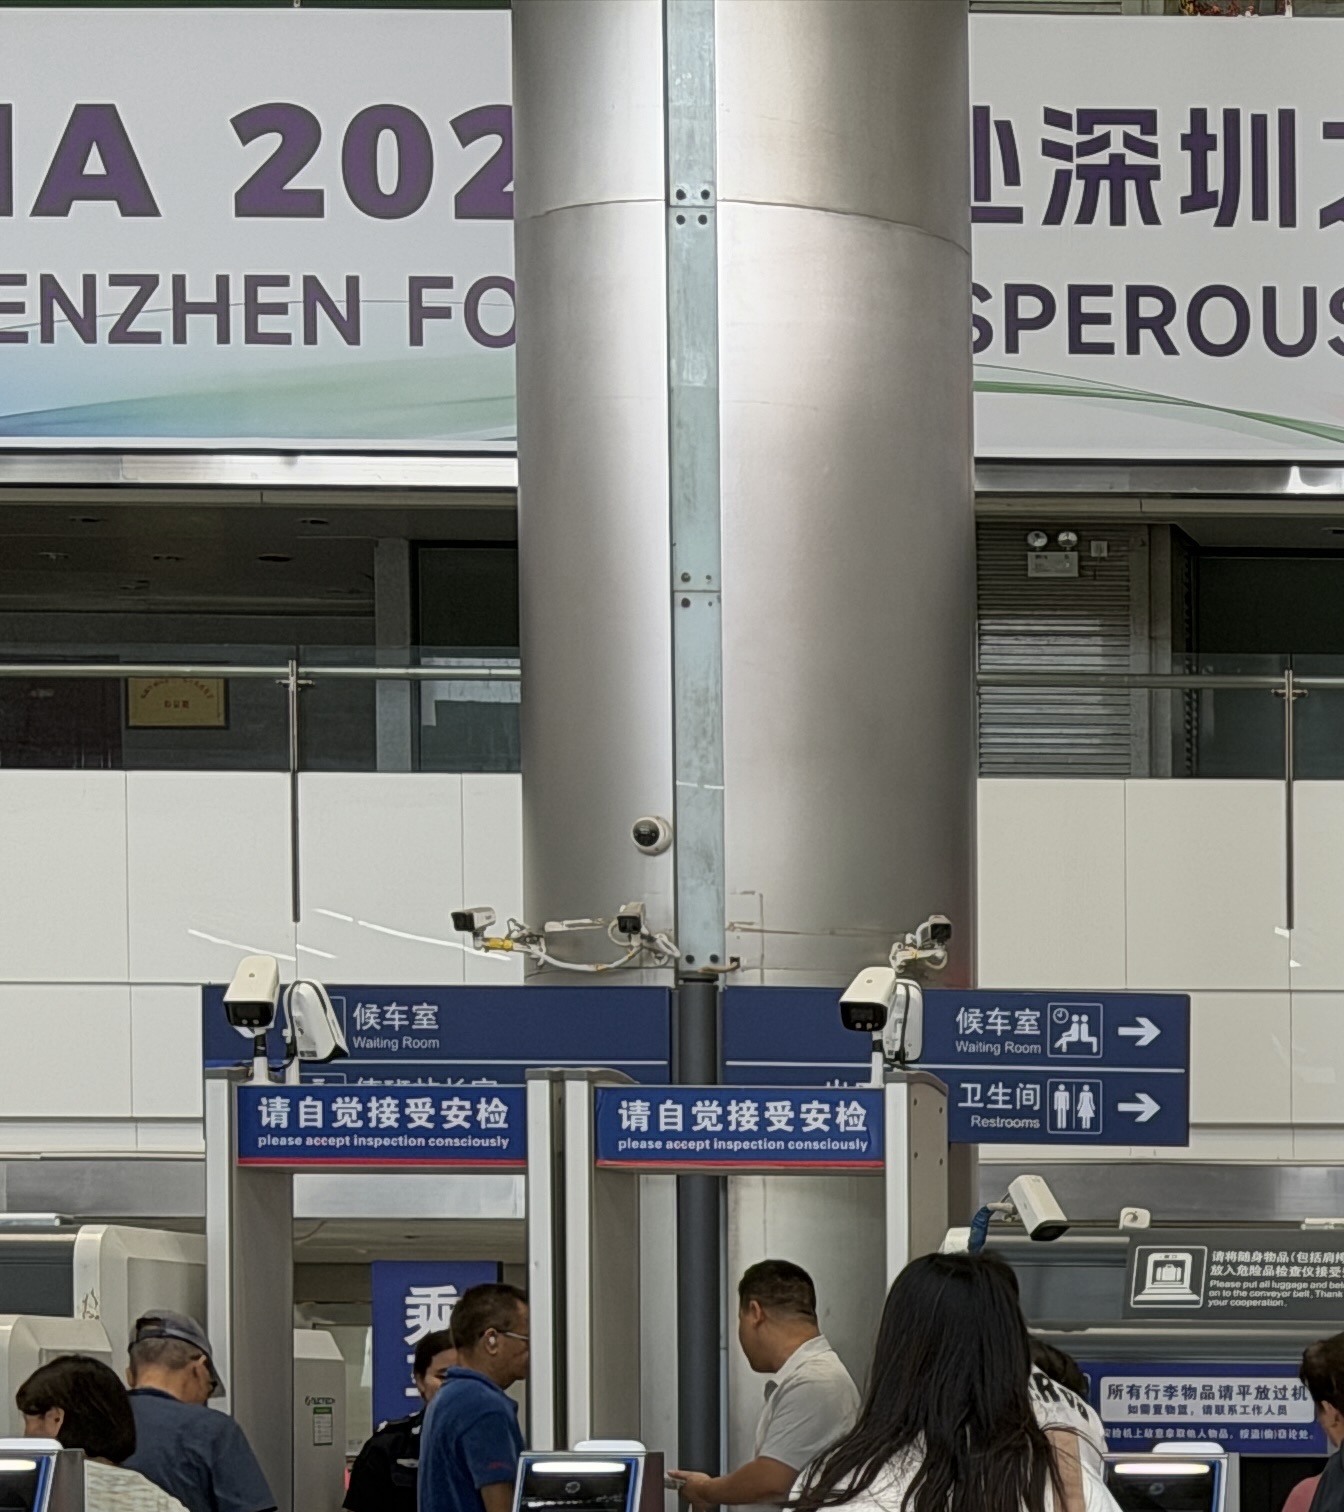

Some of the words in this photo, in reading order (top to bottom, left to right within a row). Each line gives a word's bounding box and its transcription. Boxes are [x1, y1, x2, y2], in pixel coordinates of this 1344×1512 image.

[0, 103, 161, 218] A
[353, 1002, 439, 1032] 候车室
[955, 1007, 1041, 1035] 候车室
[353, 1035, 398, 1051] Waiting
[402, 1035, 440, 1050] Room
[955, 1040, 1001, 1056] Waiting
[1004, 1040, 1042, 1055] Room
[957, 1083, 1041, 1111] 卫生间
[258, 1097, 509, 1130] 请自觉接受安检
[618, 1100, 868, 1133] 请自觉接受安检
[971, 1116, 1040, 1130] Restrooms
[258, 1135, 302, 1147] please
[306, 1136, 351, 1149] accept
[353, 1134, 426, 1149] inspection
[428, 1134, 510, 1150] consciously
[618, 1138, 663, 1152] please
[666, 1139, 710, 1152] accept
[713, 1137, 785, 1152] inspection
[788, 1138, 868, 1153] consciously
[1107, 1384, 1307, 1401] 所有行李物品请平放过机
